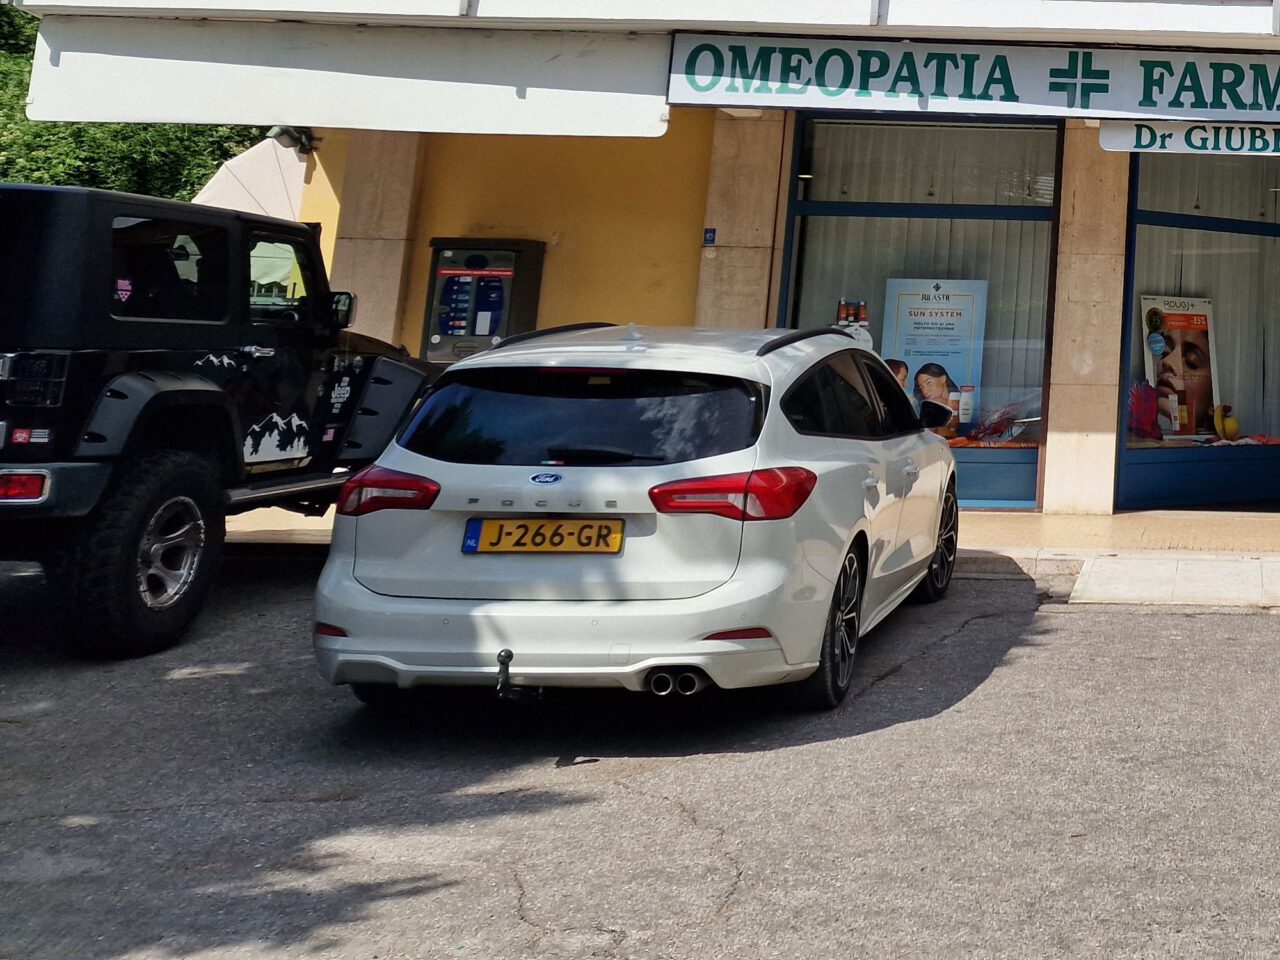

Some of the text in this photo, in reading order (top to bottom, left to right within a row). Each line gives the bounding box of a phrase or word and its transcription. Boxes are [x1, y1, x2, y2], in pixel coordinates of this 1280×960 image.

[684, 43, 1020, 103] OMEOPATIA
[1133, 124, 1173, 149] Dr
[466, 539, 477, 547] NL
[489, 524, 613, 547] J-266-GR
